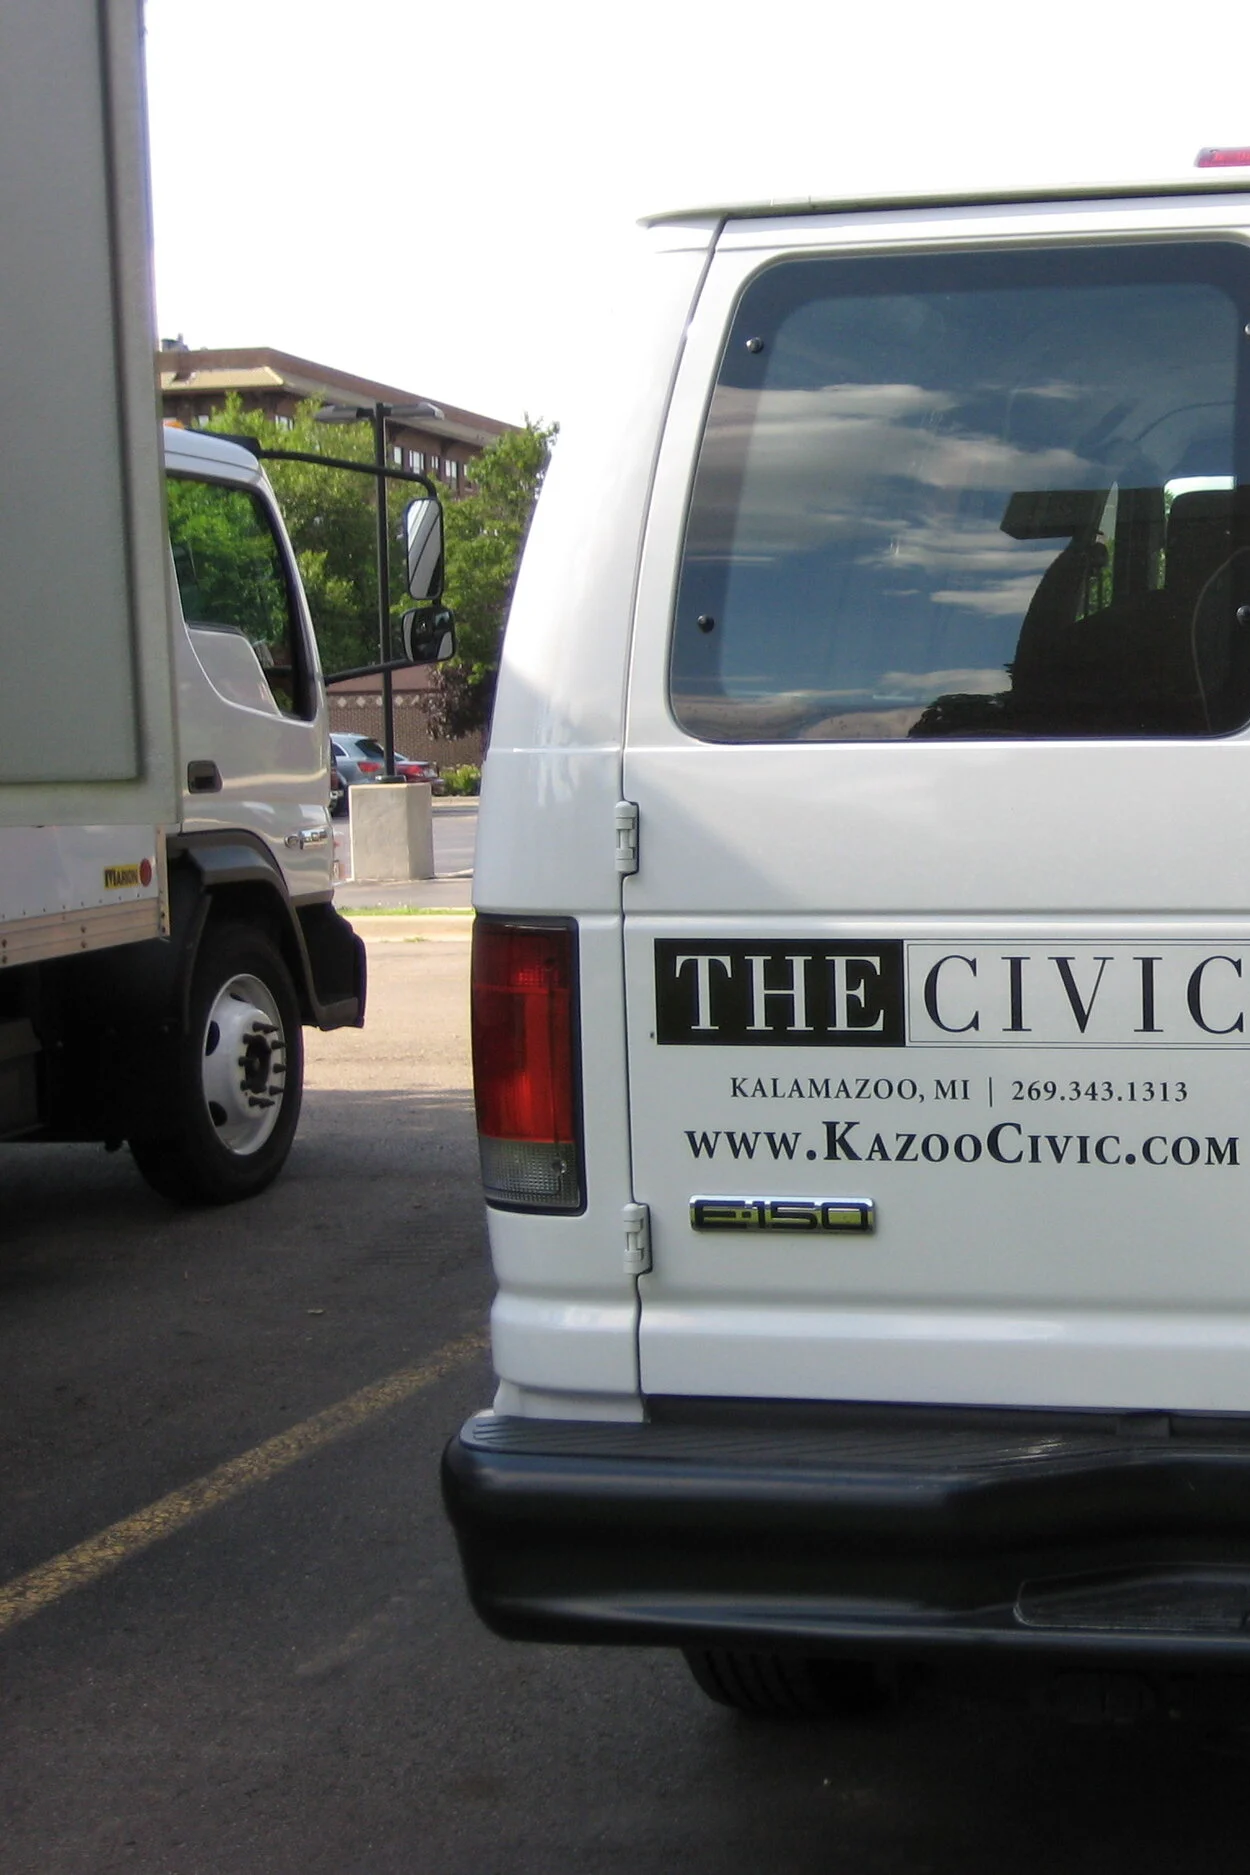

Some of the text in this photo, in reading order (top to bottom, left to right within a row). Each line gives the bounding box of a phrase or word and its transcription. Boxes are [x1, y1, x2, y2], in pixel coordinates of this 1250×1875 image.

[677, 955, 1245, 1034] THE CIVIC
[730, 1077, 1188, 1104] KALAMAZOO, MI 269.343.1313
